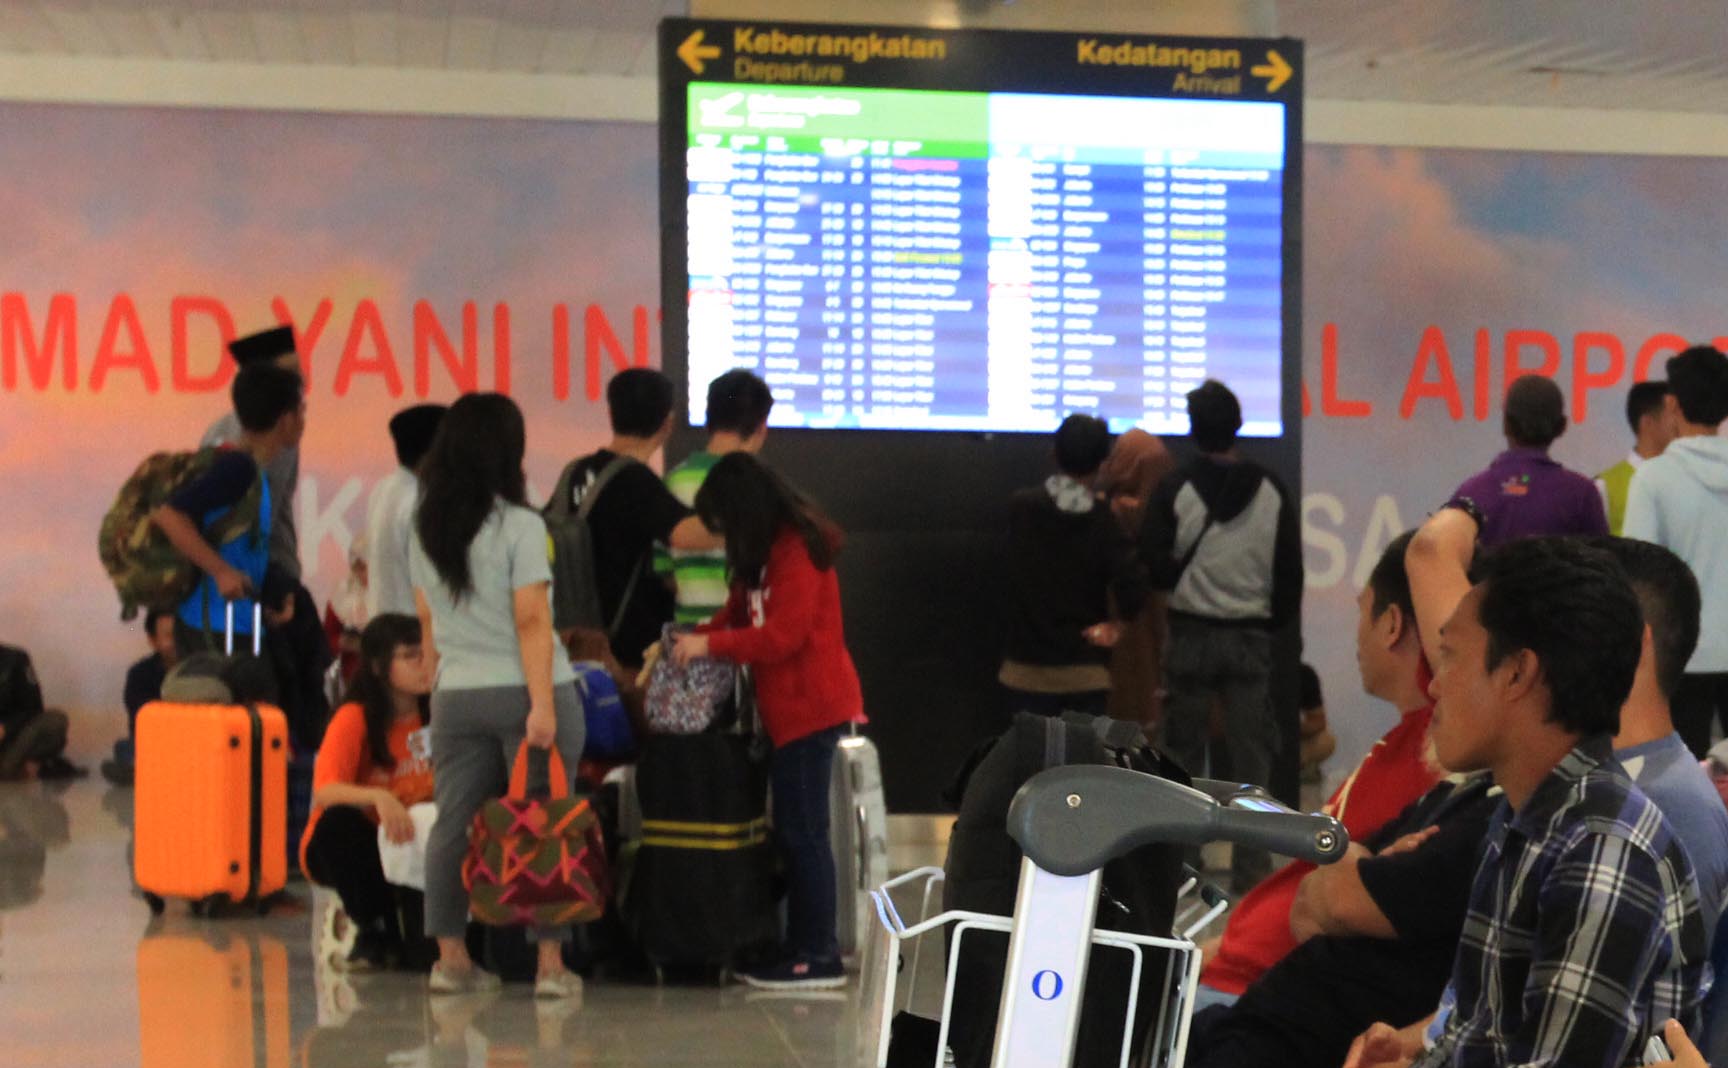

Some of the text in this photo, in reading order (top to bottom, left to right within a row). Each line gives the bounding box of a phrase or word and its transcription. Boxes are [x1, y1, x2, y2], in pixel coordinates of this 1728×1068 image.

[733, 28, 947, 62] Keberangkatan
[1078, 40, 1241, 71] Kedatangan
[734, 57, 845, 82] Departure
[1174, 73, 1241, 94] Arrival
[271, 297, 511, 397] YANI
[554, 304, 661, 401] IN
